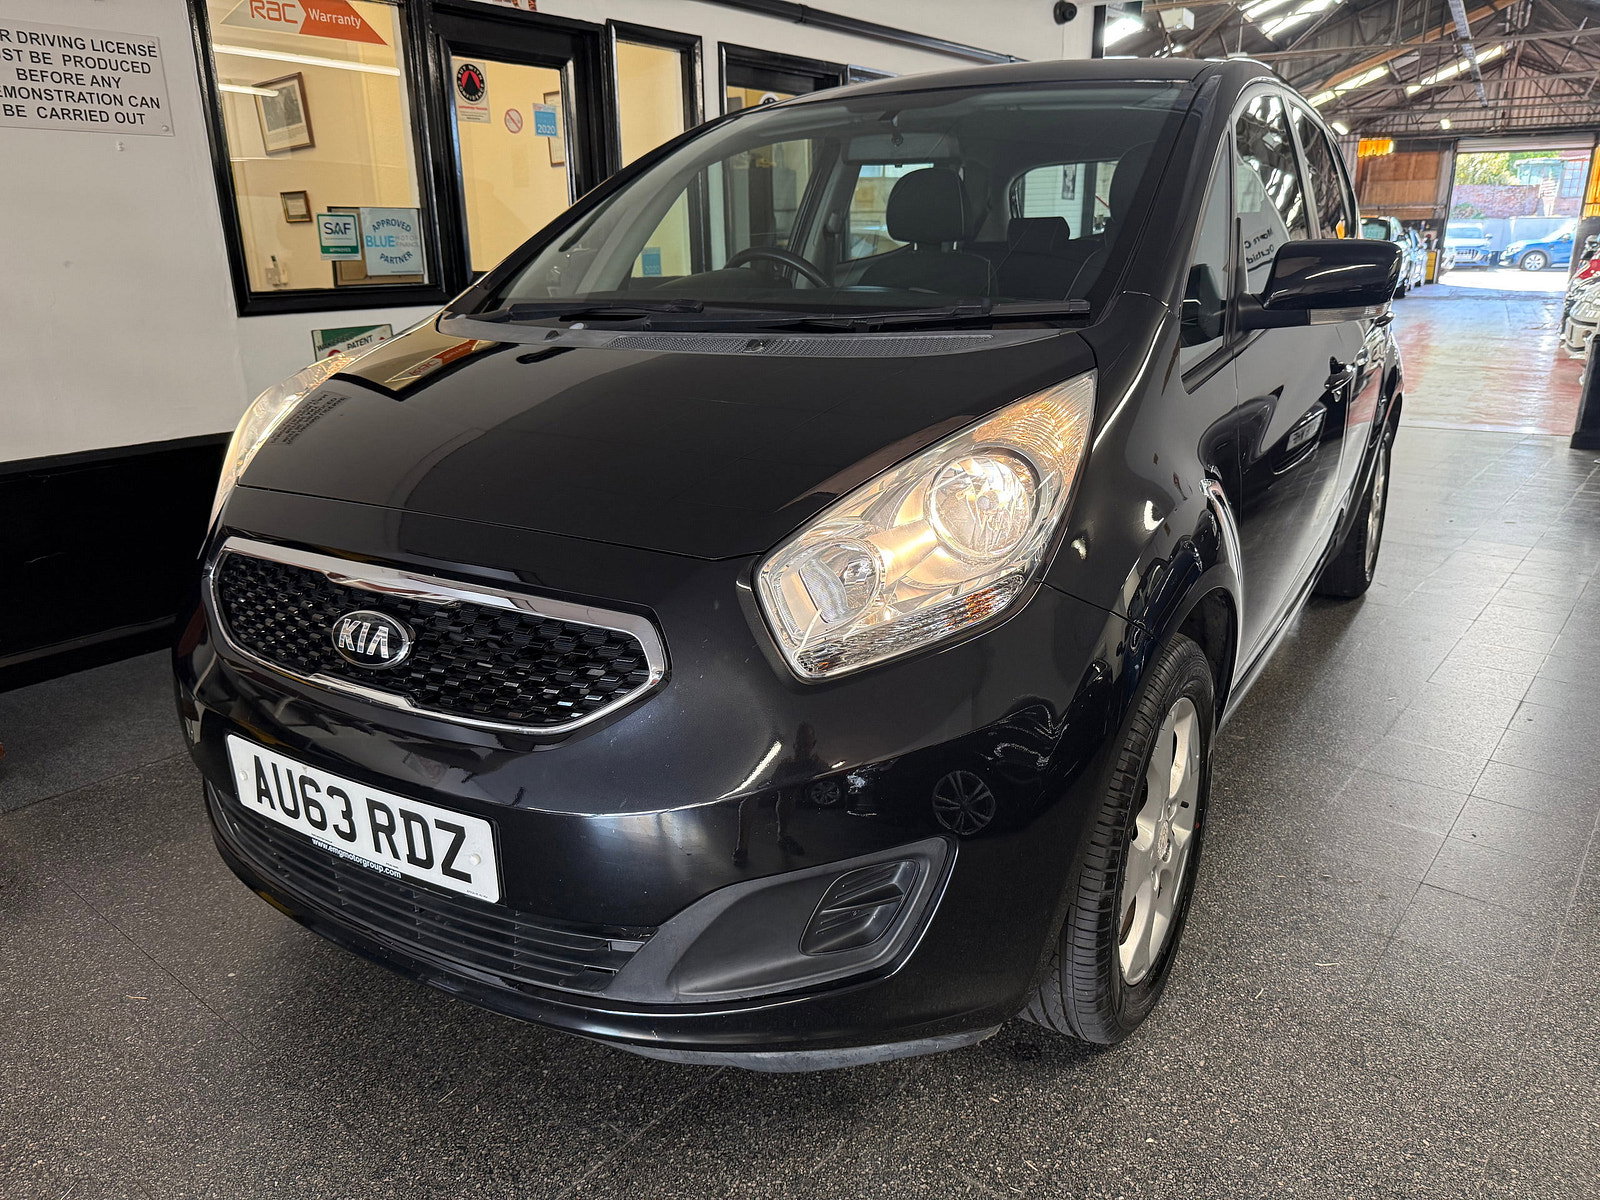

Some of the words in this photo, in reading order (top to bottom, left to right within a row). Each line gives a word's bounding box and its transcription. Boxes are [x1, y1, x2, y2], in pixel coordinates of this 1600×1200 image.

[308, 8, 362, 29] Warranty
[16, 30, 86, 50] DRIVING
[90, 39, 158, 58] LICENSE
[0, 48, 23, 62] ST
[29, 51, 53, 65] BE
[62, 54, 151, 74] PRODUCED
[16, 68, 86, 86] BEFORE
[90, 75, 121, 89] ANY
[128, 95, 161, 109] CAN
[2, 104, 27, 118] BE
[36, 106, 109, 123] CARRIED
[114, 111, 146, 125] OUT
[537, 124, 557, 135] 2020
[323, 222, 351, 235] SAF
[372, 218, 412, 232] APPROVED
[365, 235, 395, 247] BLUE
[380, 251, 413, 264] PARTNER
[347, 335, 373, 350] PATENT
[338, 618, 390, 659] KIA
[253, 754, 357, 843] AU63
[365, 797, 473, 885] RDZ
[311, 837, 402, 879] www.emgmotorgroup.com
